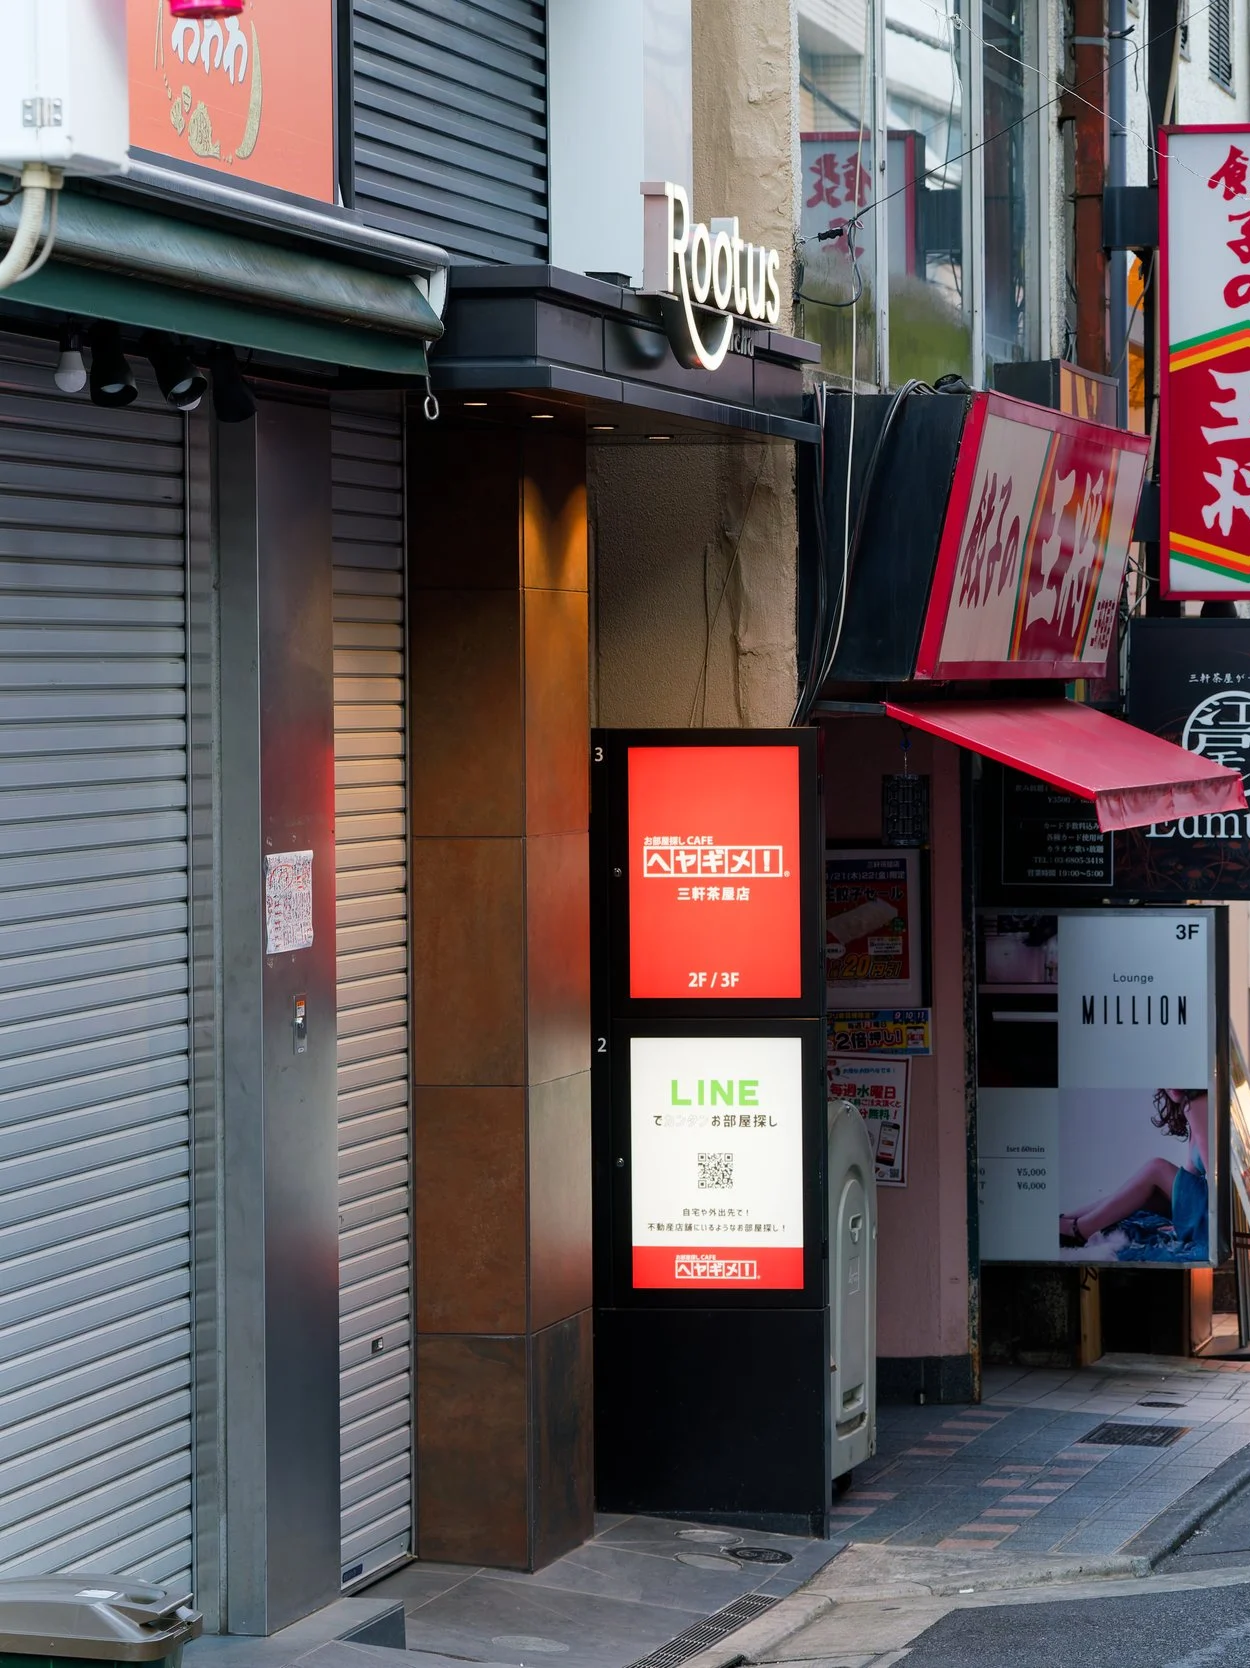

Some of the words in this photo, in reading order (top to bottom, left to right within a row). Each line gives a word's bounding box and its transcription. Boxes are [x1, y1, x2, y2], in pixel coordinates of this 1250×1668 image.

[594, 747, 604, 762] 3
[677, 886, 750, 901] 三軒茶屋店
[1175, 924, 1200, 940] 3F
[688, 972, 707, 987] 2F
[720, 972, 739, 987] 3F
[1113, 973, 1154, 984] Lounge
[1082, 995, 1187, 1025] MILLION
[597, 1037, 607, 1053] 2
[671, 1079, 760, 1106] LINE
[1017, 1168, 1046, 1177] ¥5,000
[1017, 1182, 1046, 1191] ¥6,000
